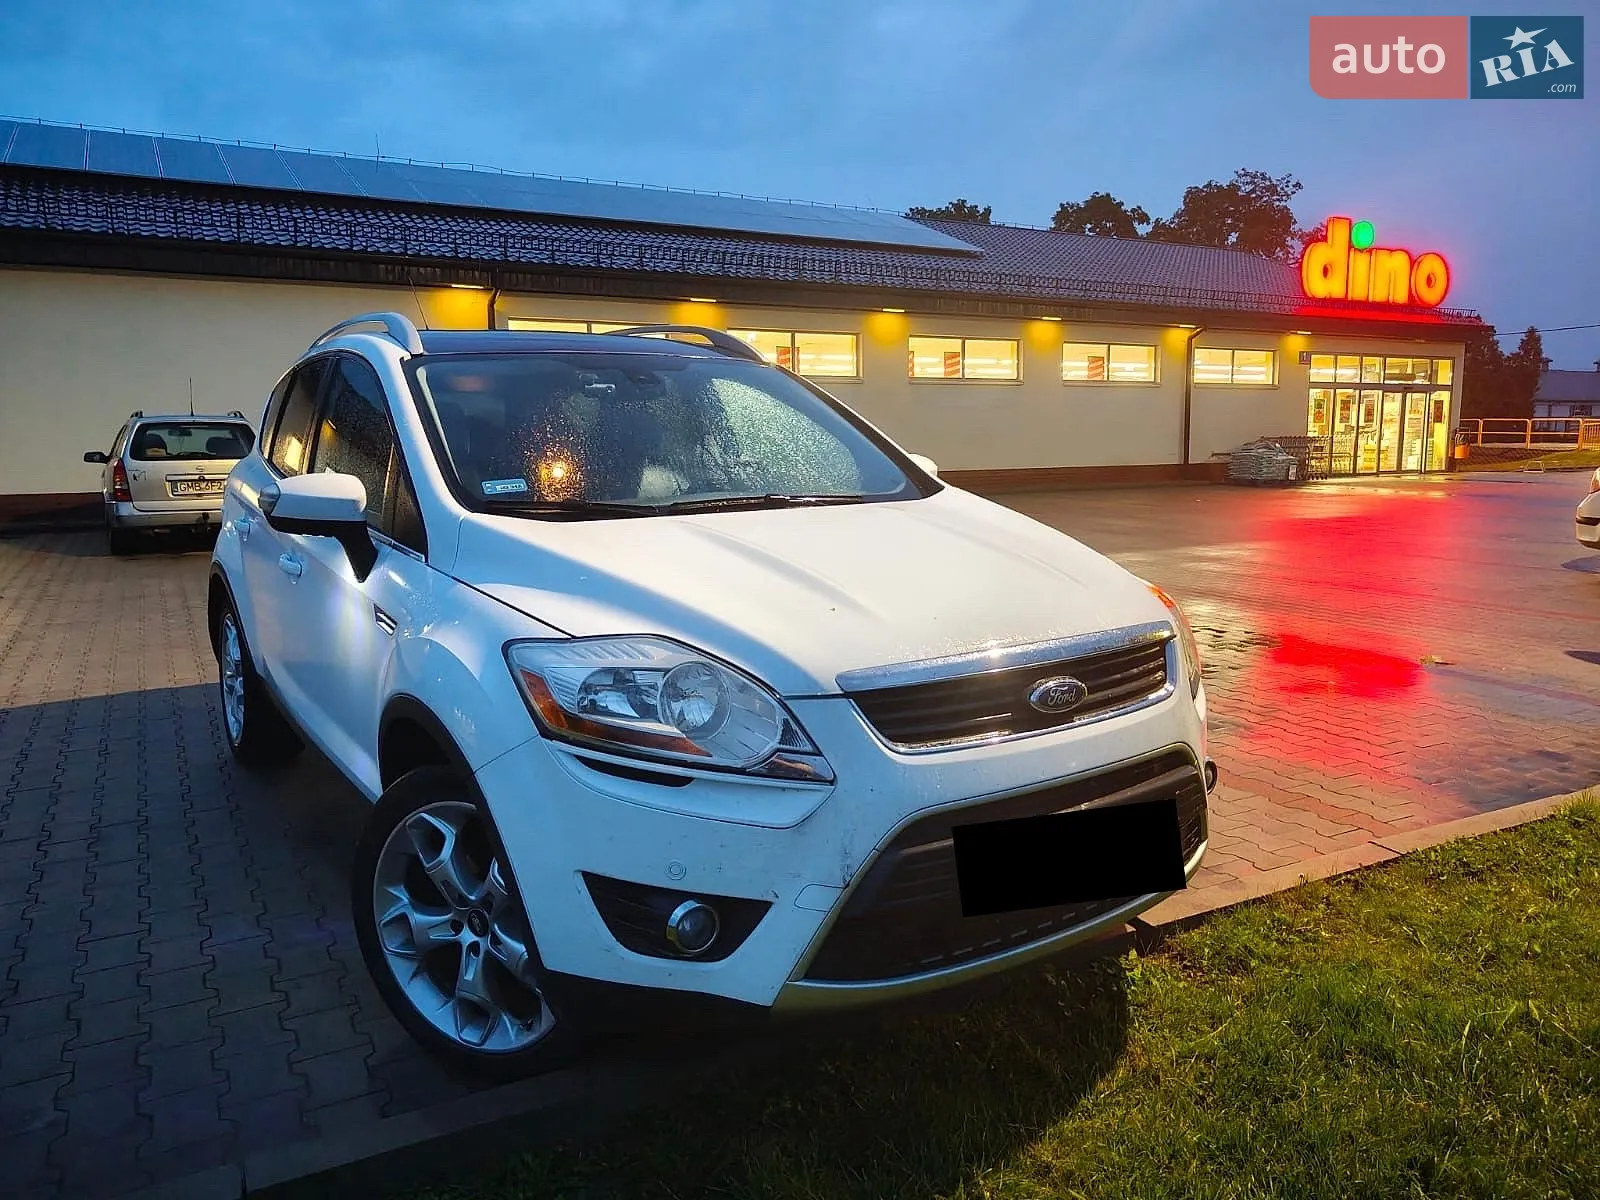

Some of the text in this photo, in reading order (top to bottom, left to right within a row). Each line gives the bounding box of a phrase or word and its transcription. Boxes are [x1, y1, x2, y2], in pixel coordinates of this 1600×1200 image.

[1302, 216, 1450, 307] dino
[179, 482, 202, 492] GMB
[1047, 686, 1076, 706] Ford
